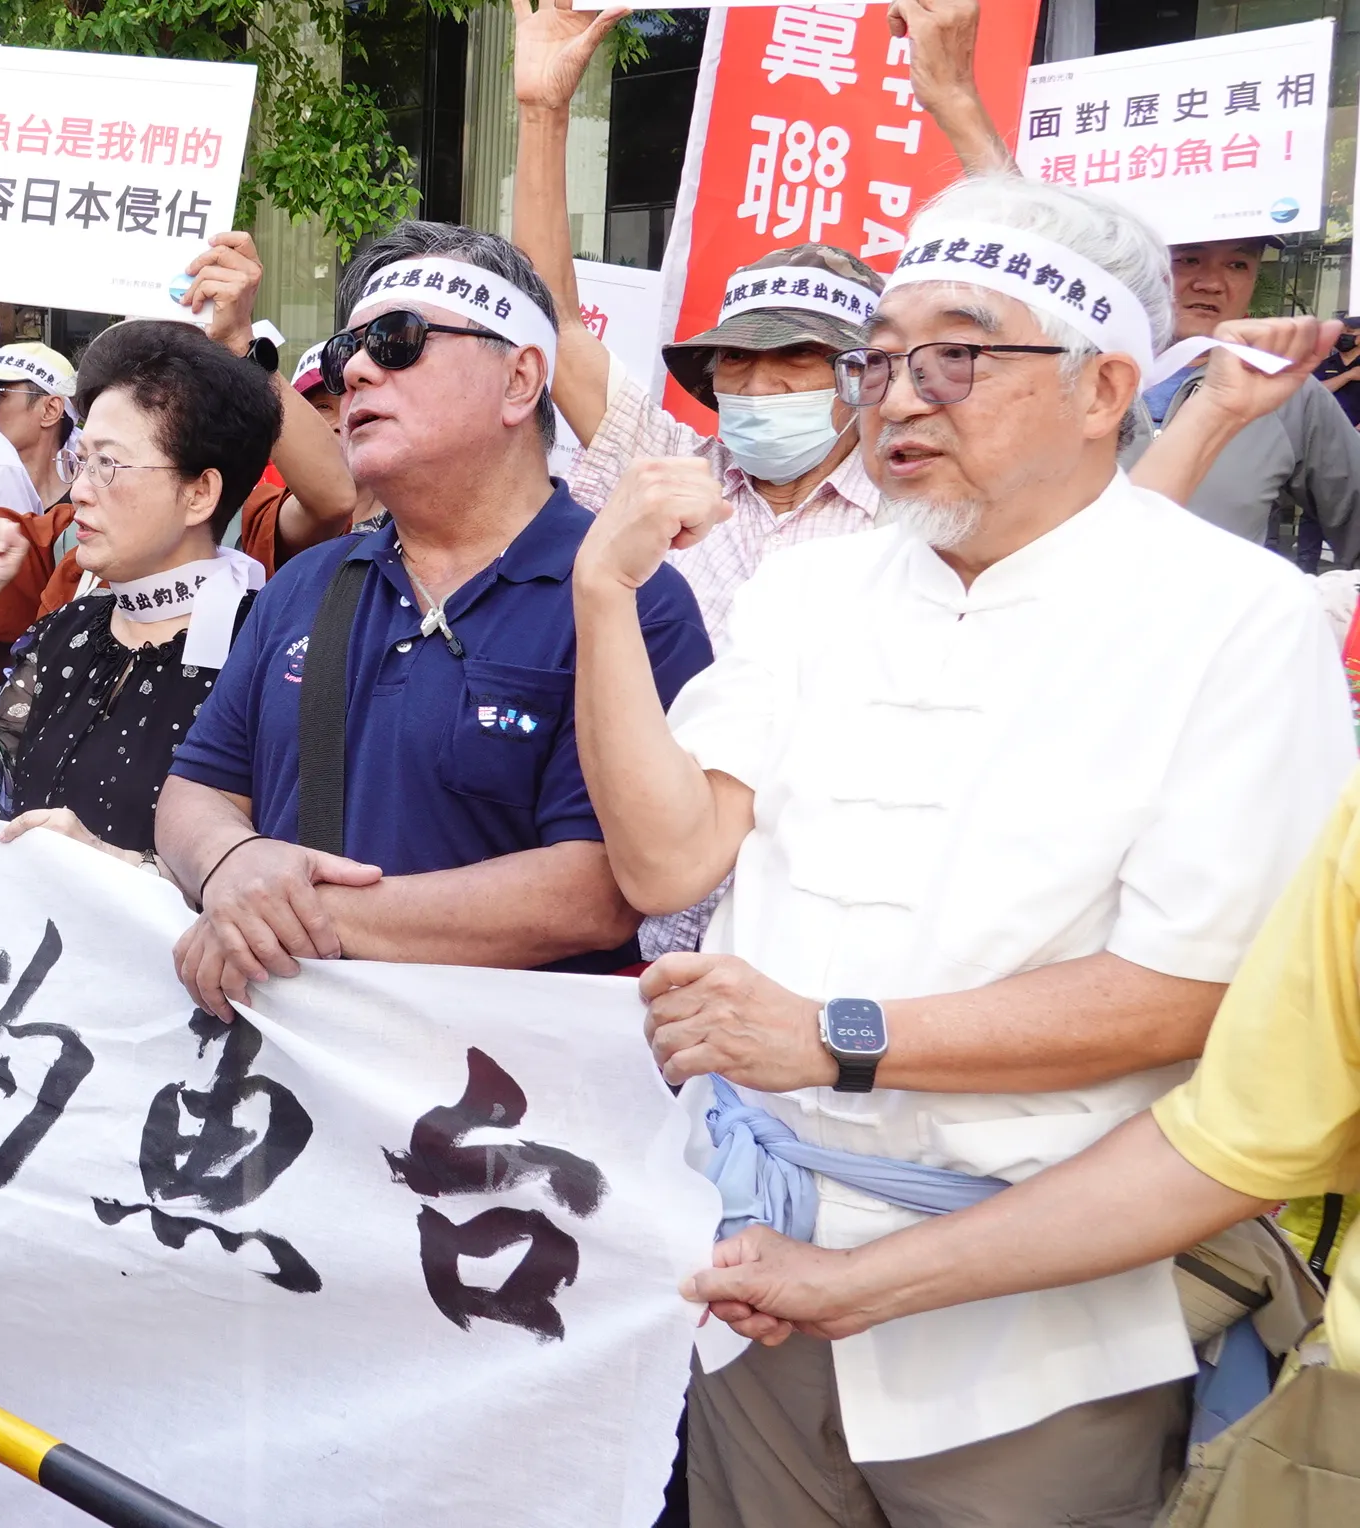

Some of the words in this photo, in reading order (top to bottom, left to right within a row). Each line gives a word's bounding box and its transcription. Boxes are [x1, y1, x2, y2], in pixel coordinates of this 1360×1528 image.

[874, 37, 926, 155] EFT
[1029, 73, 1314, 140] 面對歷史真相
[859, 180, 912, 258] PA
[362, 268, 512, 320] 歷史退出釣魚台
